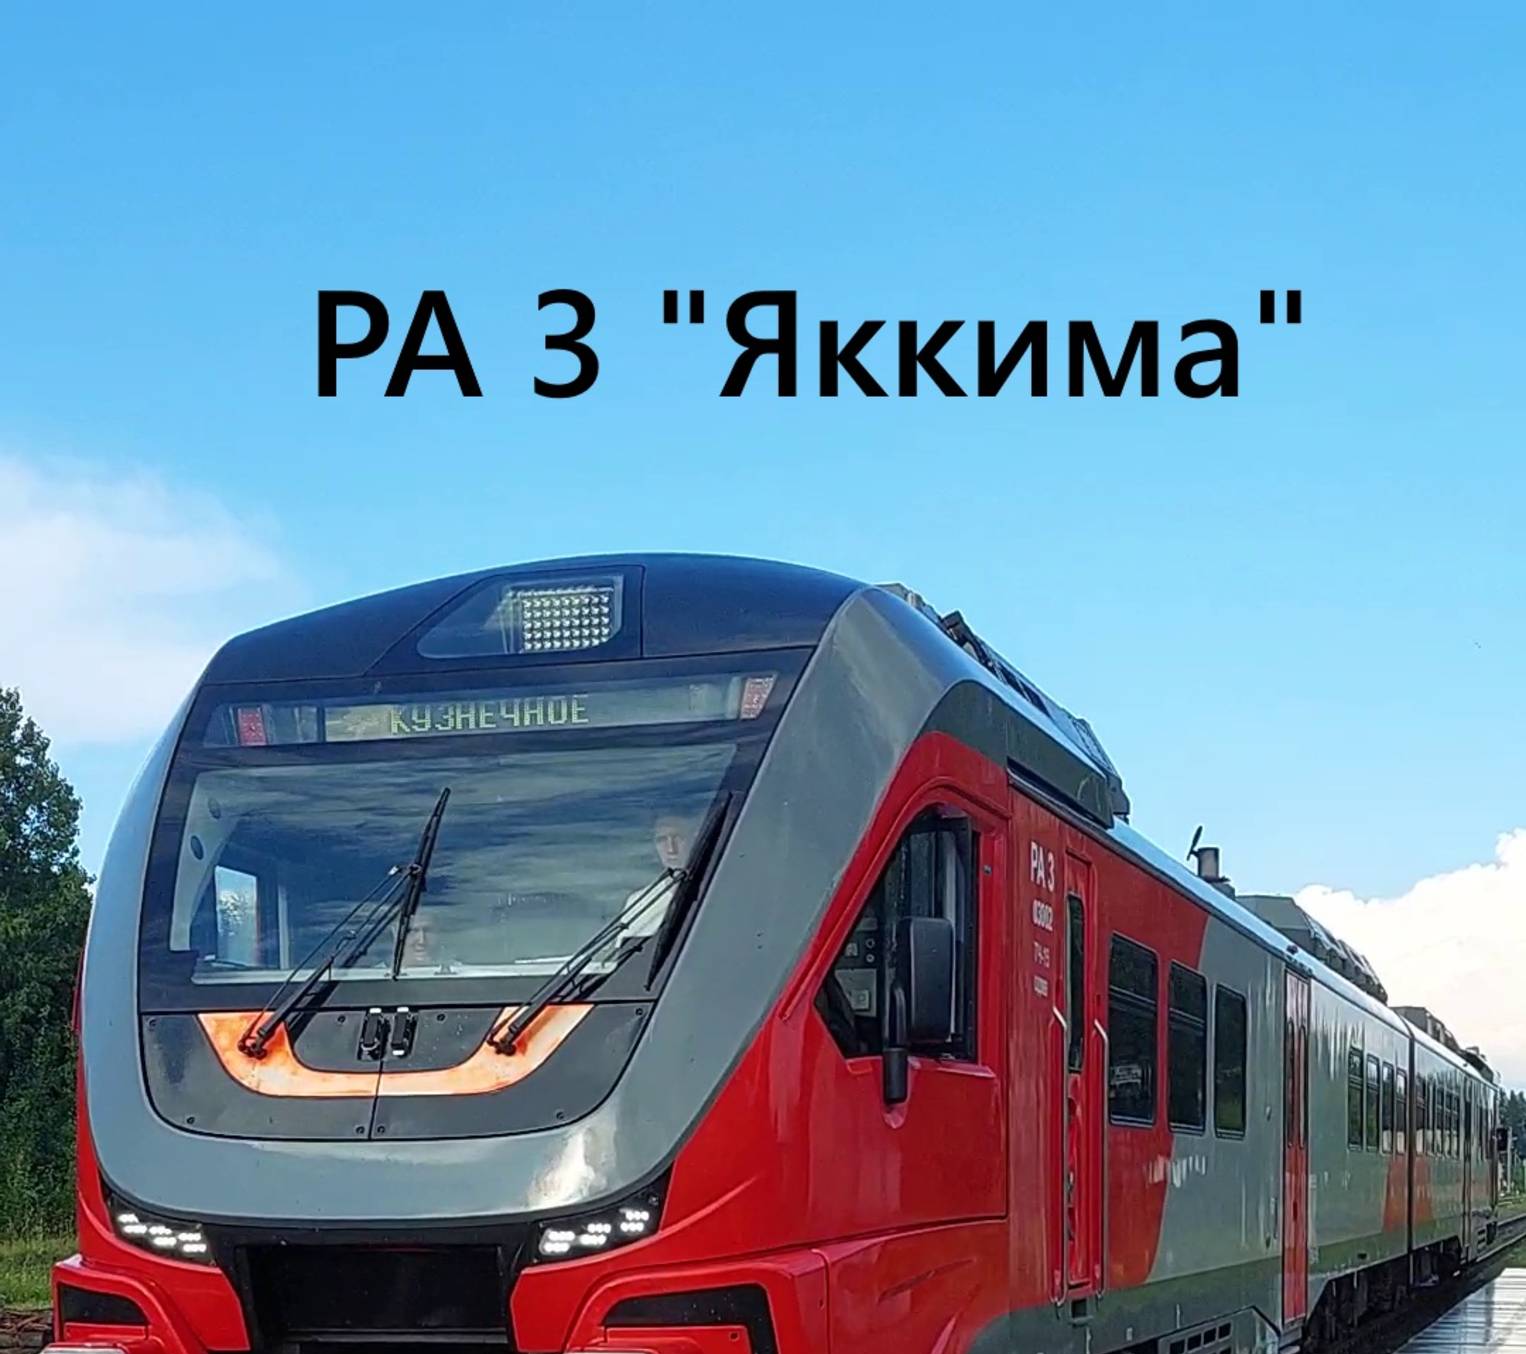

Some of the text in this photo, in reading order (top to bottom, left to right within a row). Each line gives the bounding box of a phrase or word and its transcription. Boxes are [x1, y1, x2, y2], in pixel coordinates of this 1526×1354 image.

[389, 694, 590, 734] КУЗНЕЧНОЕ
[1030, 840, 1055, 892] РА 3
